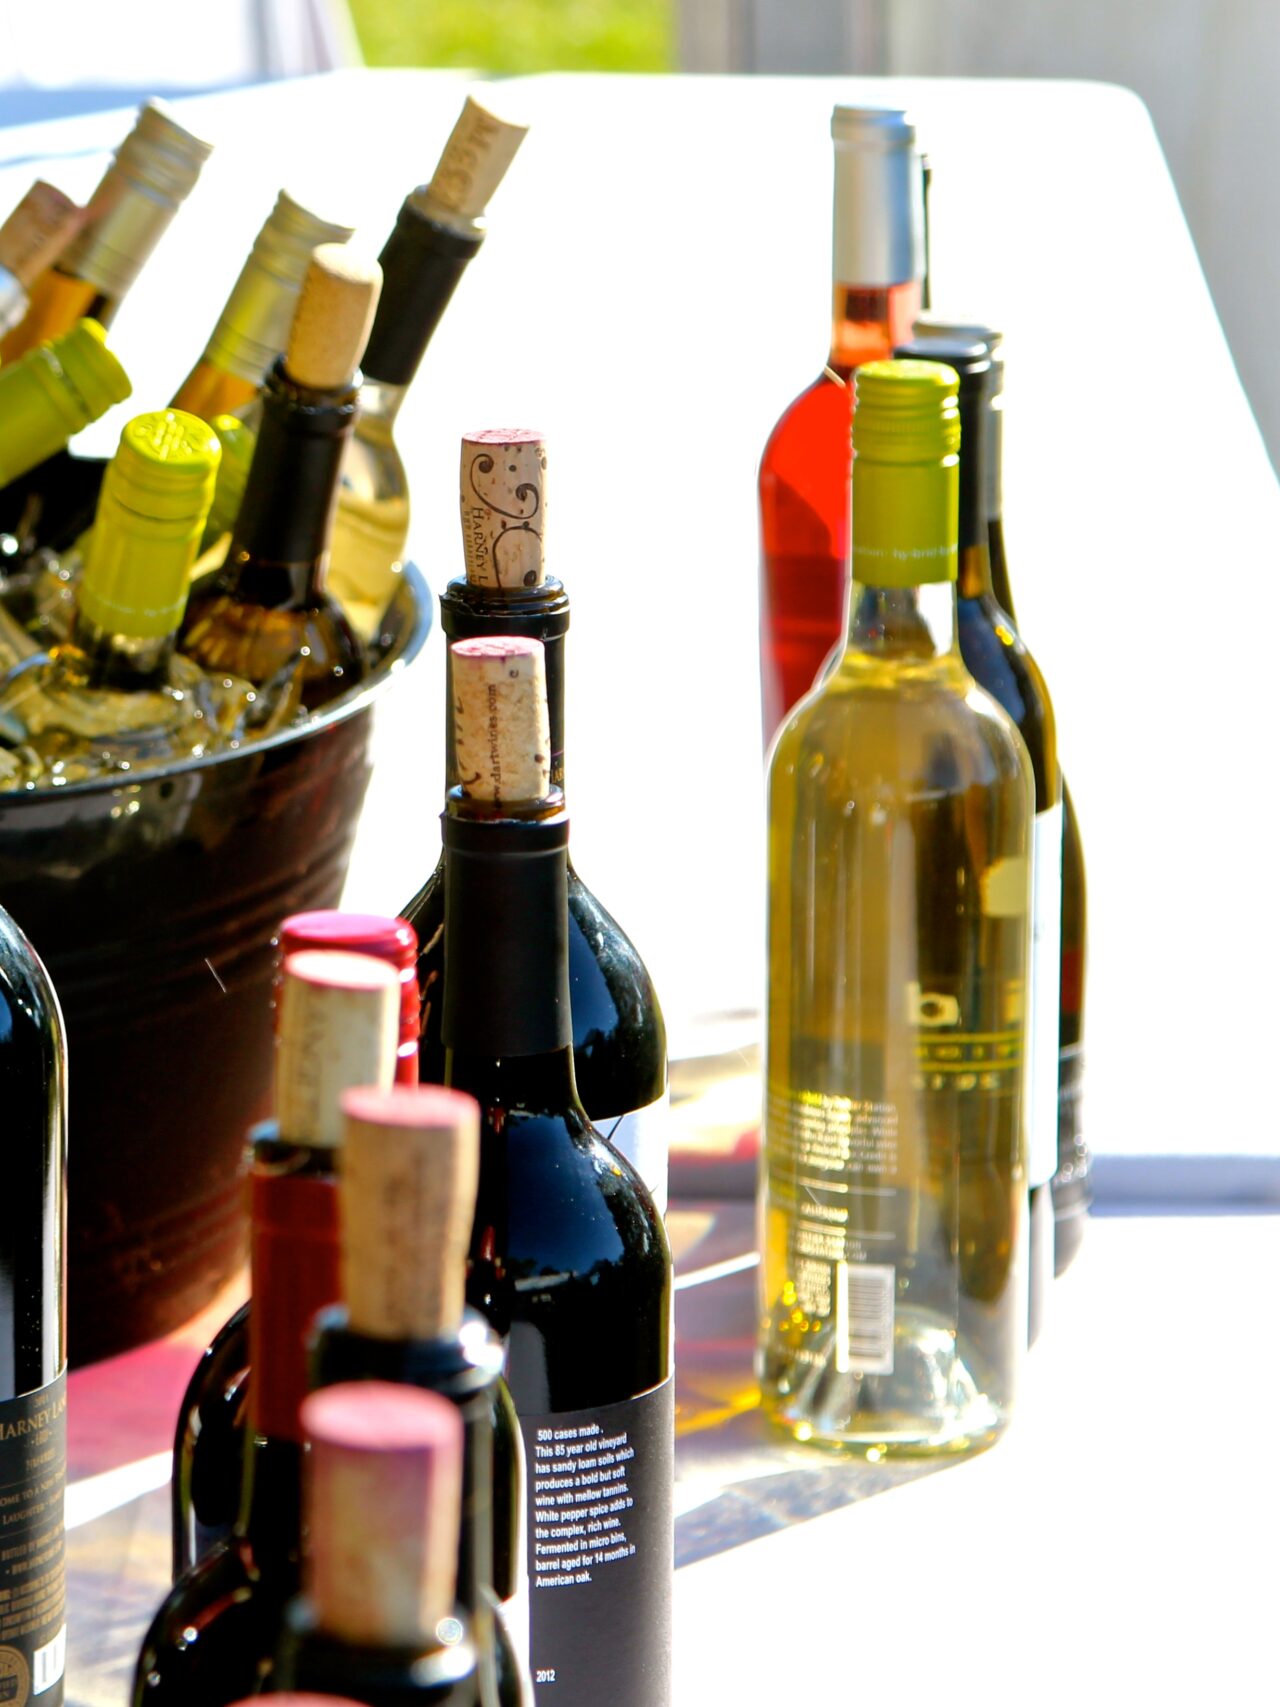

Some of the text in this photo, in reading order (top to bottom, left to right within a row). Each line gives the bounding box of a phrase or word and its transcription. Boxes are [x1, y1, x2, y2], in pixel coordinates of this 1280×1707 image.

[472, 507, 488, 571] HARNEY
[537, 1429, 552, 1441] 500
[554, 1428, 577, 1440] cases
[579, 1423, 600, 1436] made
[535, 1432, 627, 1458] This 85 year old vineyard
[535, 1446, 635, 1474] has sandy loam soils which
[535, 1466, 626, 1493] produces a bold but soft
[535, 1483, 629, 1507] wine with mellow tannins.
[535, 1497, 634, 1523] White pepper spice adds to
[535, 1517, 621, 1539] the complex, rich wine.
[535, 1532, 627, 1555] Fermented in micro bins,
[535, 1543, 636, 1572] barrel aged for 14 months in
[535, 1570, 592, 1588] American oak.
[536, 1669, 556, 1682] 2012
